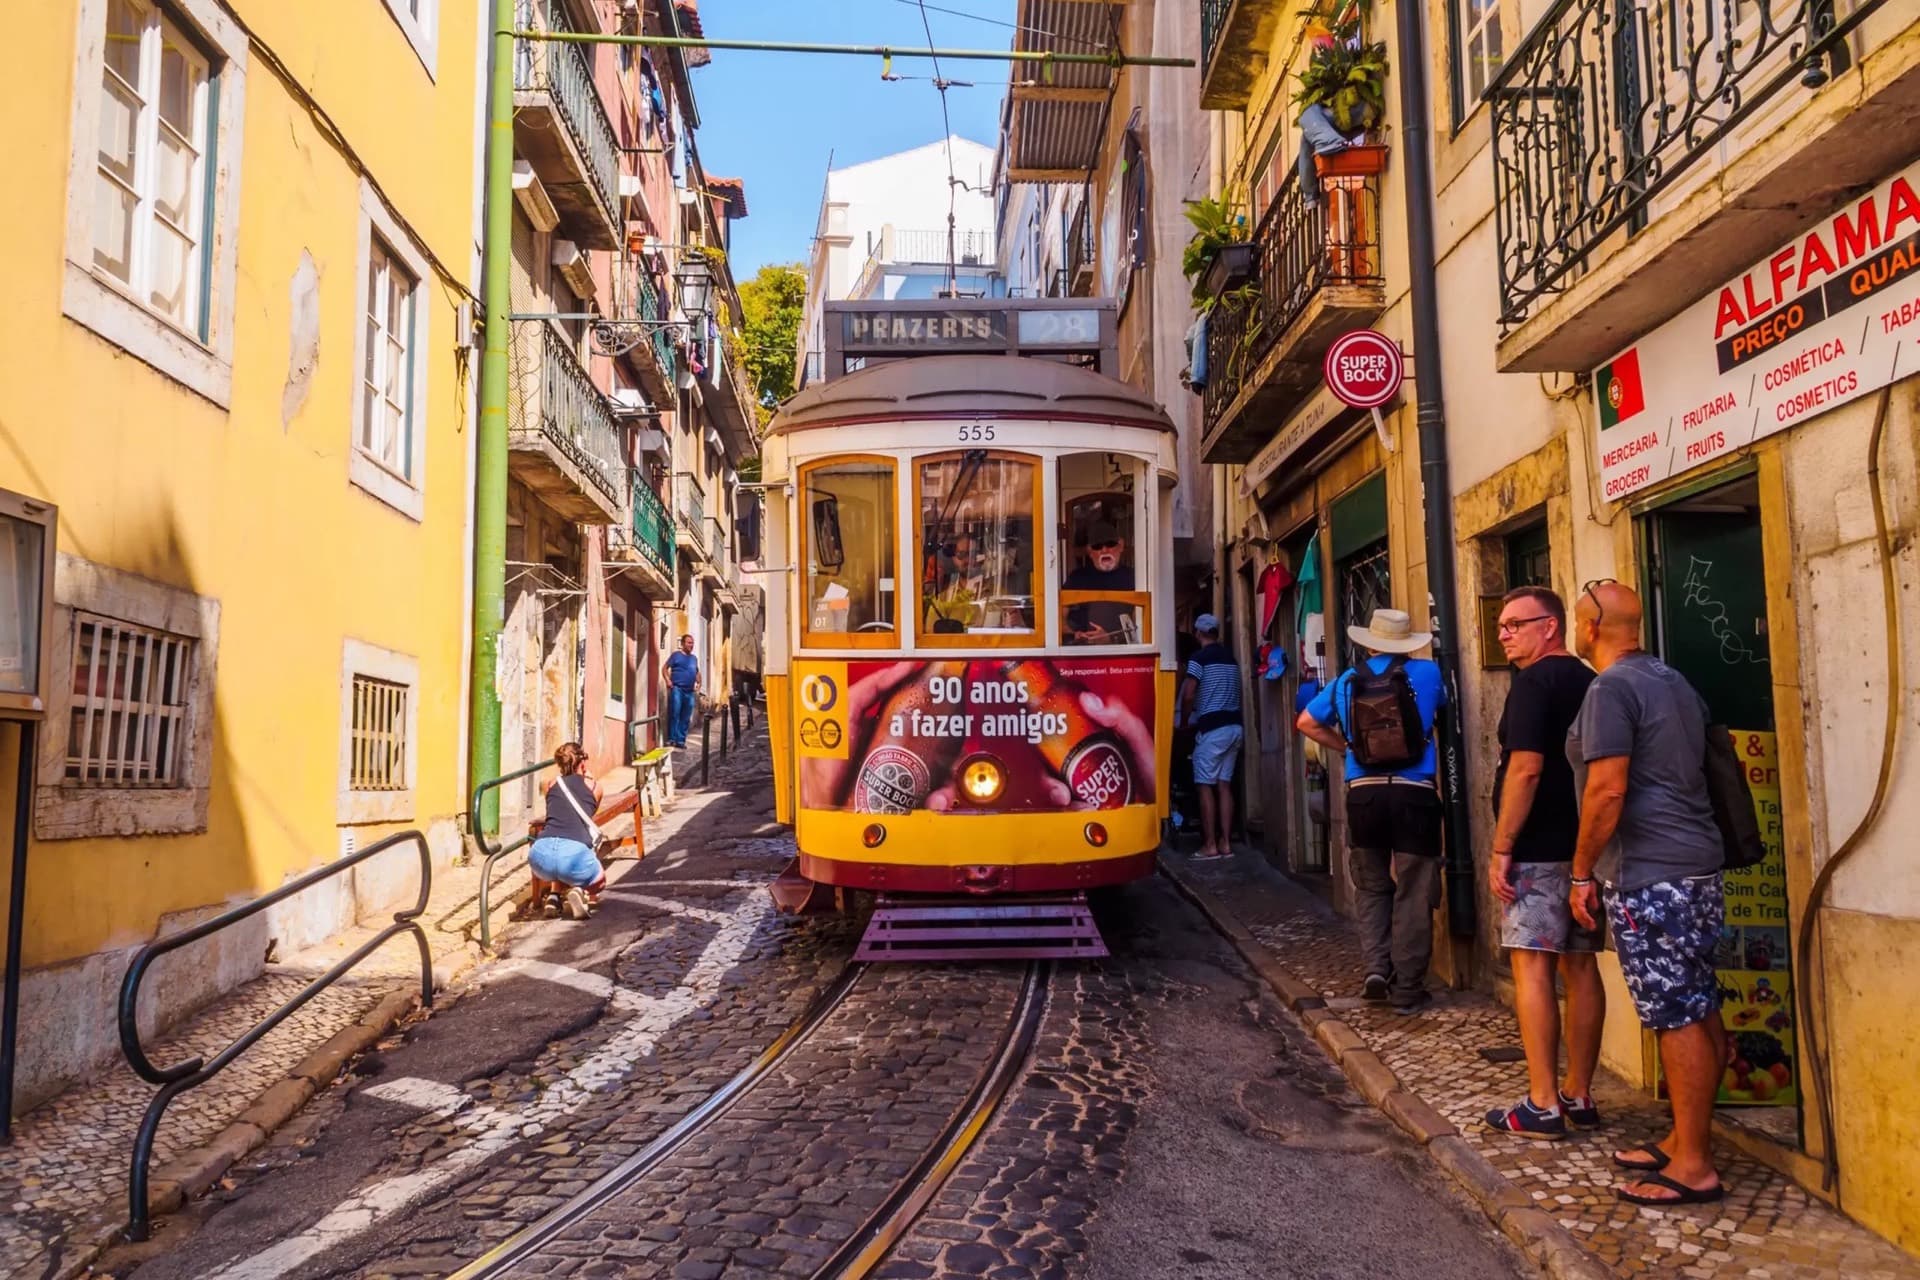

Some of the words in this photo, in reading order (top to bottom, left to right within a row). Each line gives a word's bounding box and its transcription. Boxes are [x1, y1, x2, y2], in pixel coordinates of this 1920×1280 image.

[1714, 177, 1920, 340] ALFAMA
[1732, 305, 1805, 361] PREÇO
[1850, 241, 1920, 296] QUAL
[853, 316, 992, 339] PRAZERES
[1040, 315, 1086, 342] 28
[1340, 355, 1387, 370] SUPER
[1343, 368, 1386, 383] BOCK
[1602, 432, 1659, 469] MERCEARIA
[1682, 391, 1737, 431] FRUTARIA
[1764, 338, 1846, 391] COSMÉTICA
[958, 425, 996, 442] 555
[1605, 464, 1650, 497] GROCERY
[1686, 431, 1725, 462] FRUITS
[1776, 371, 1858, 422] COSMETICS
[929, 676, 963, 704] 90
[970, 680, 1029, 704] anos
[889, 714, 904, 737] a
[911, 708, 974, 737] fazer
[981, 708, 1068, 744] amigos
[863, 770, 891, 798] SUPER
[1076, 755, 1118, 799] SUPER
[1086, 768, 1125, 809] BOCK
[1724, 881, 1754, 897] Sim
[1732, 903, 1752, 918] de
